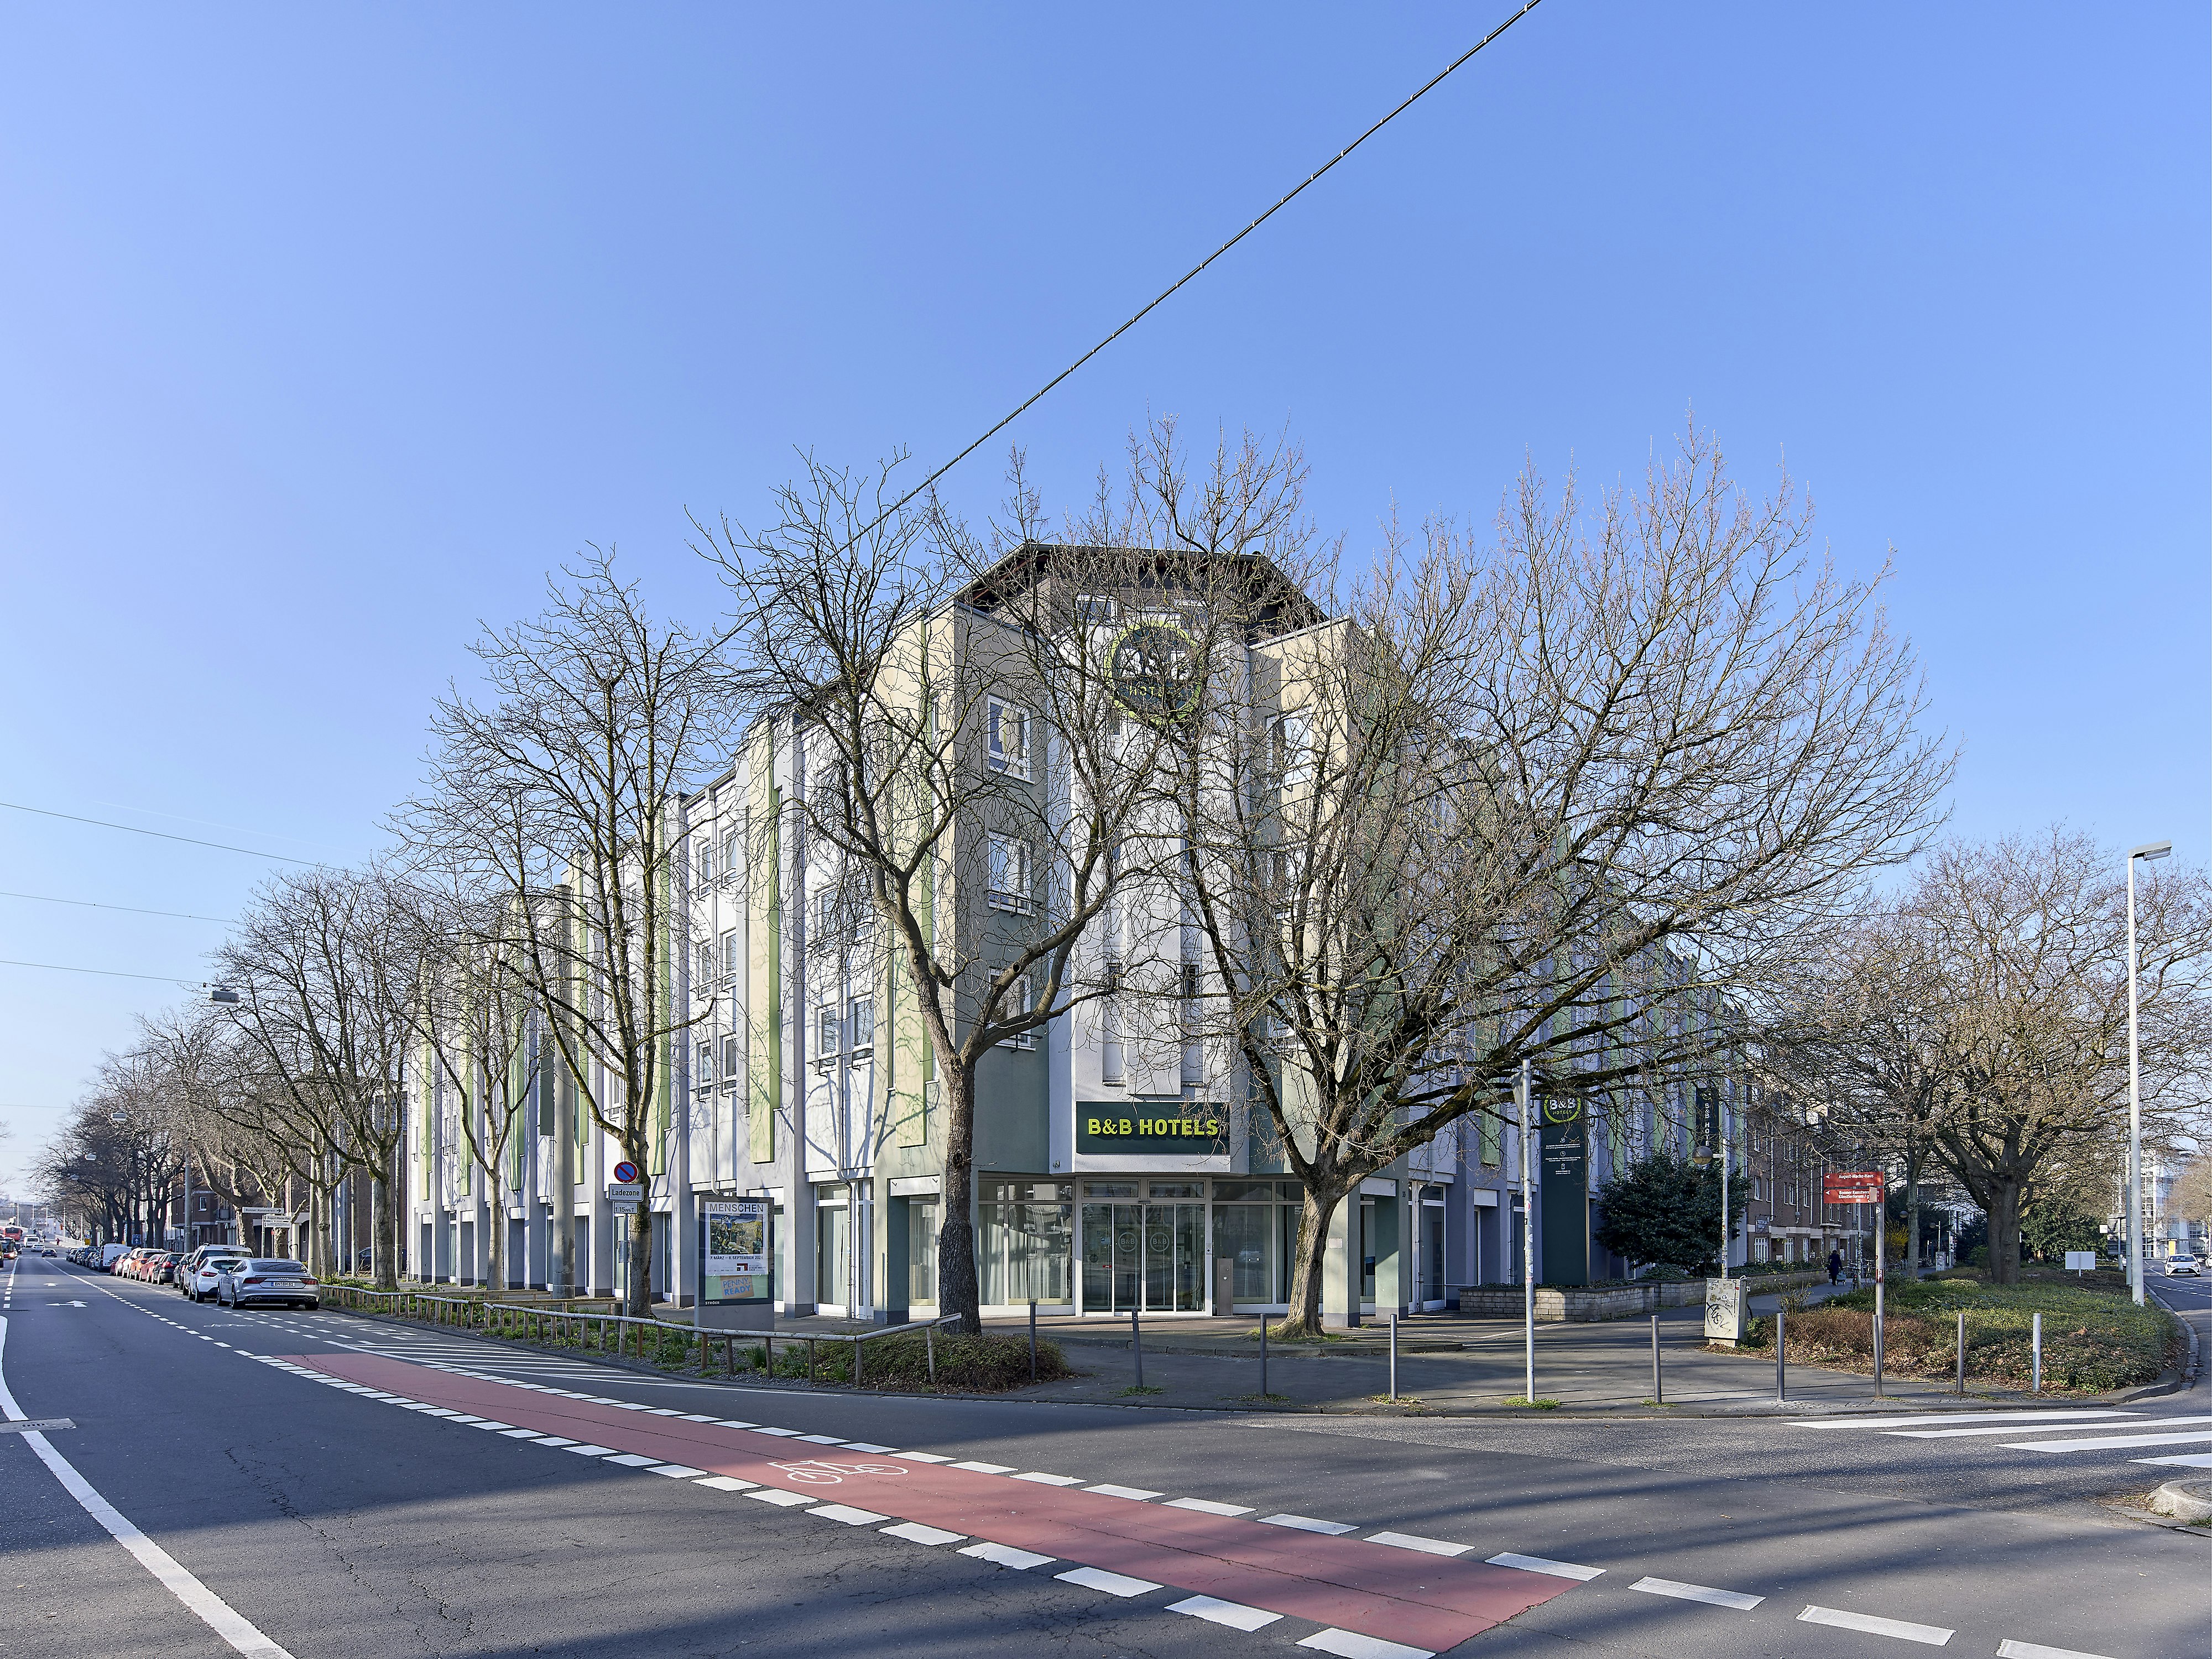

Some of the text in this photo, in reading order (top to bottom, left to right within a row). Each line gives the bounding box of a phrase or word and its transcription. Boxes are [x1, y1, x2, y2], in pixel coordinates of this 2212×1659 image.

[1550, 1098, 1576, 1110] B&B
[1088, 1119, 1219, 1135] B&B HOTELS
[709, 1203, 763, 1212] MENSCHEN
[724, 1285, 751, 1296] READY
